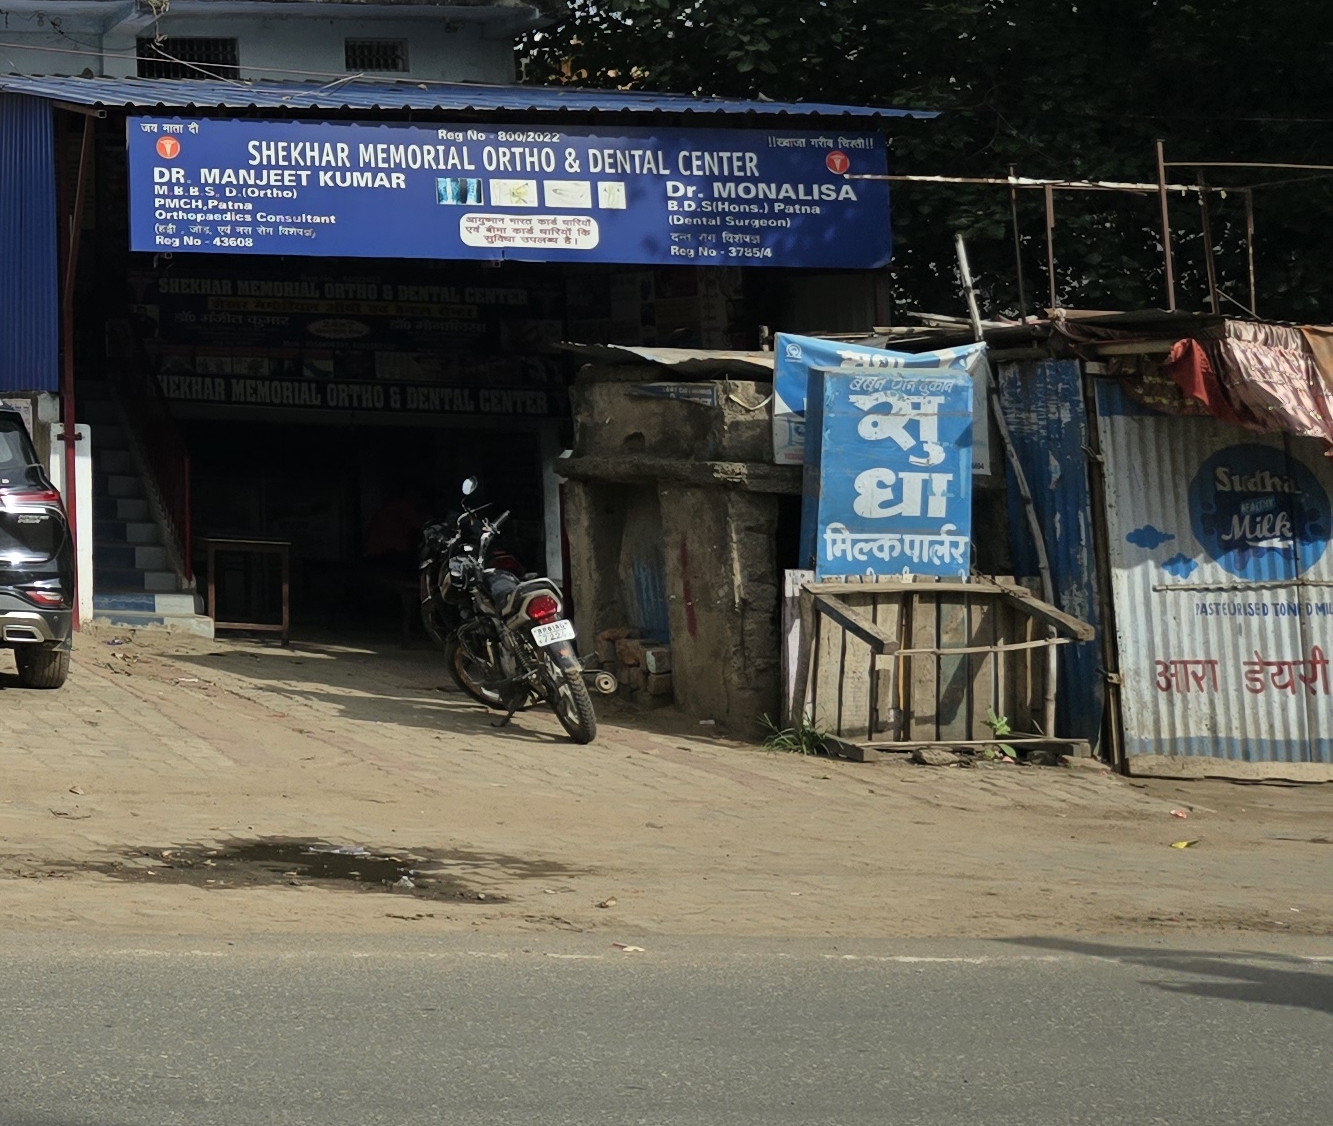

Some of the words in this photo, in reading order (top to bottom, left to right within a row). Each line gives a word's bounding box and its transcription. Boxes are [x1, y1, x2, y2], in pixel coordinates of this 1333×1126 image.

[140, 123, 158, 133] जय
[163, 123, 183, 134] माता
[188, 122, 199, 134] दी
[438, 130, 463, 142] Reg
[467, 130, 486, 141] No
[498, 131, 560, 142] 800/2022
[248, 140, 351, 167] SHEKHAR
[359, 142, 475, 170] MEMORIAL
[483, 146, 555, 173] ORTHO
[565, 148, 581, 173] &
[588, 148, 670, 175] DENTAL
[678, 151, 759, 177] CENTER
[153, 167, 192, 184] DR.
[200, 168, 311, 187] MANJEET
[319, 171, 406, 188] KUMAR
[666, 181, 704, 198] Dr.
[713, 182, 858, 201] MONALISA
[774, 202, 820, 214] Patna
[155, 210, 252, 222] Orthopaedics
[256, 212, 336, 224] Consultant
[668, 215, 721, 226] (Dental
[726, 217, 791, 229] Surgeon)
[156, 236, 180, 247] Reg
[184, 236, 201, 246] No
[213, 237, 253, 247] 43608
[670, 246, 695, 258] Reg
[699, 246, 716, 257] No
[728, 247, 773, 258] 3785/4
[158, 278, 233, 295] SHEKHAR
[237, 280, 320, 298] MEMORIAL
[324, 282, 378, 300] ORTHO
[398, 285, 461, 303] DENTAL
[465, 287, 528, 305] CENTER
[157, 375, 226, 402] HEKHAR
[231, 378, 321, 406] MEMORIAL
[326, 383, 384, 409] ORTHO
[406, 386, 474, 412] DENTAL
[479, 390, 549, 415] CENTER
[1221, 512, 1294, 540] Milk
[824, 522, 902, 562] मिल्क
[902, 523, 970, 566] पार्लर
[1196, 602, 1269, 616] PASTEURISED
[1155, 659, 1219, 694] आरा
[1243, 645, 1330, 696] डेयरी
